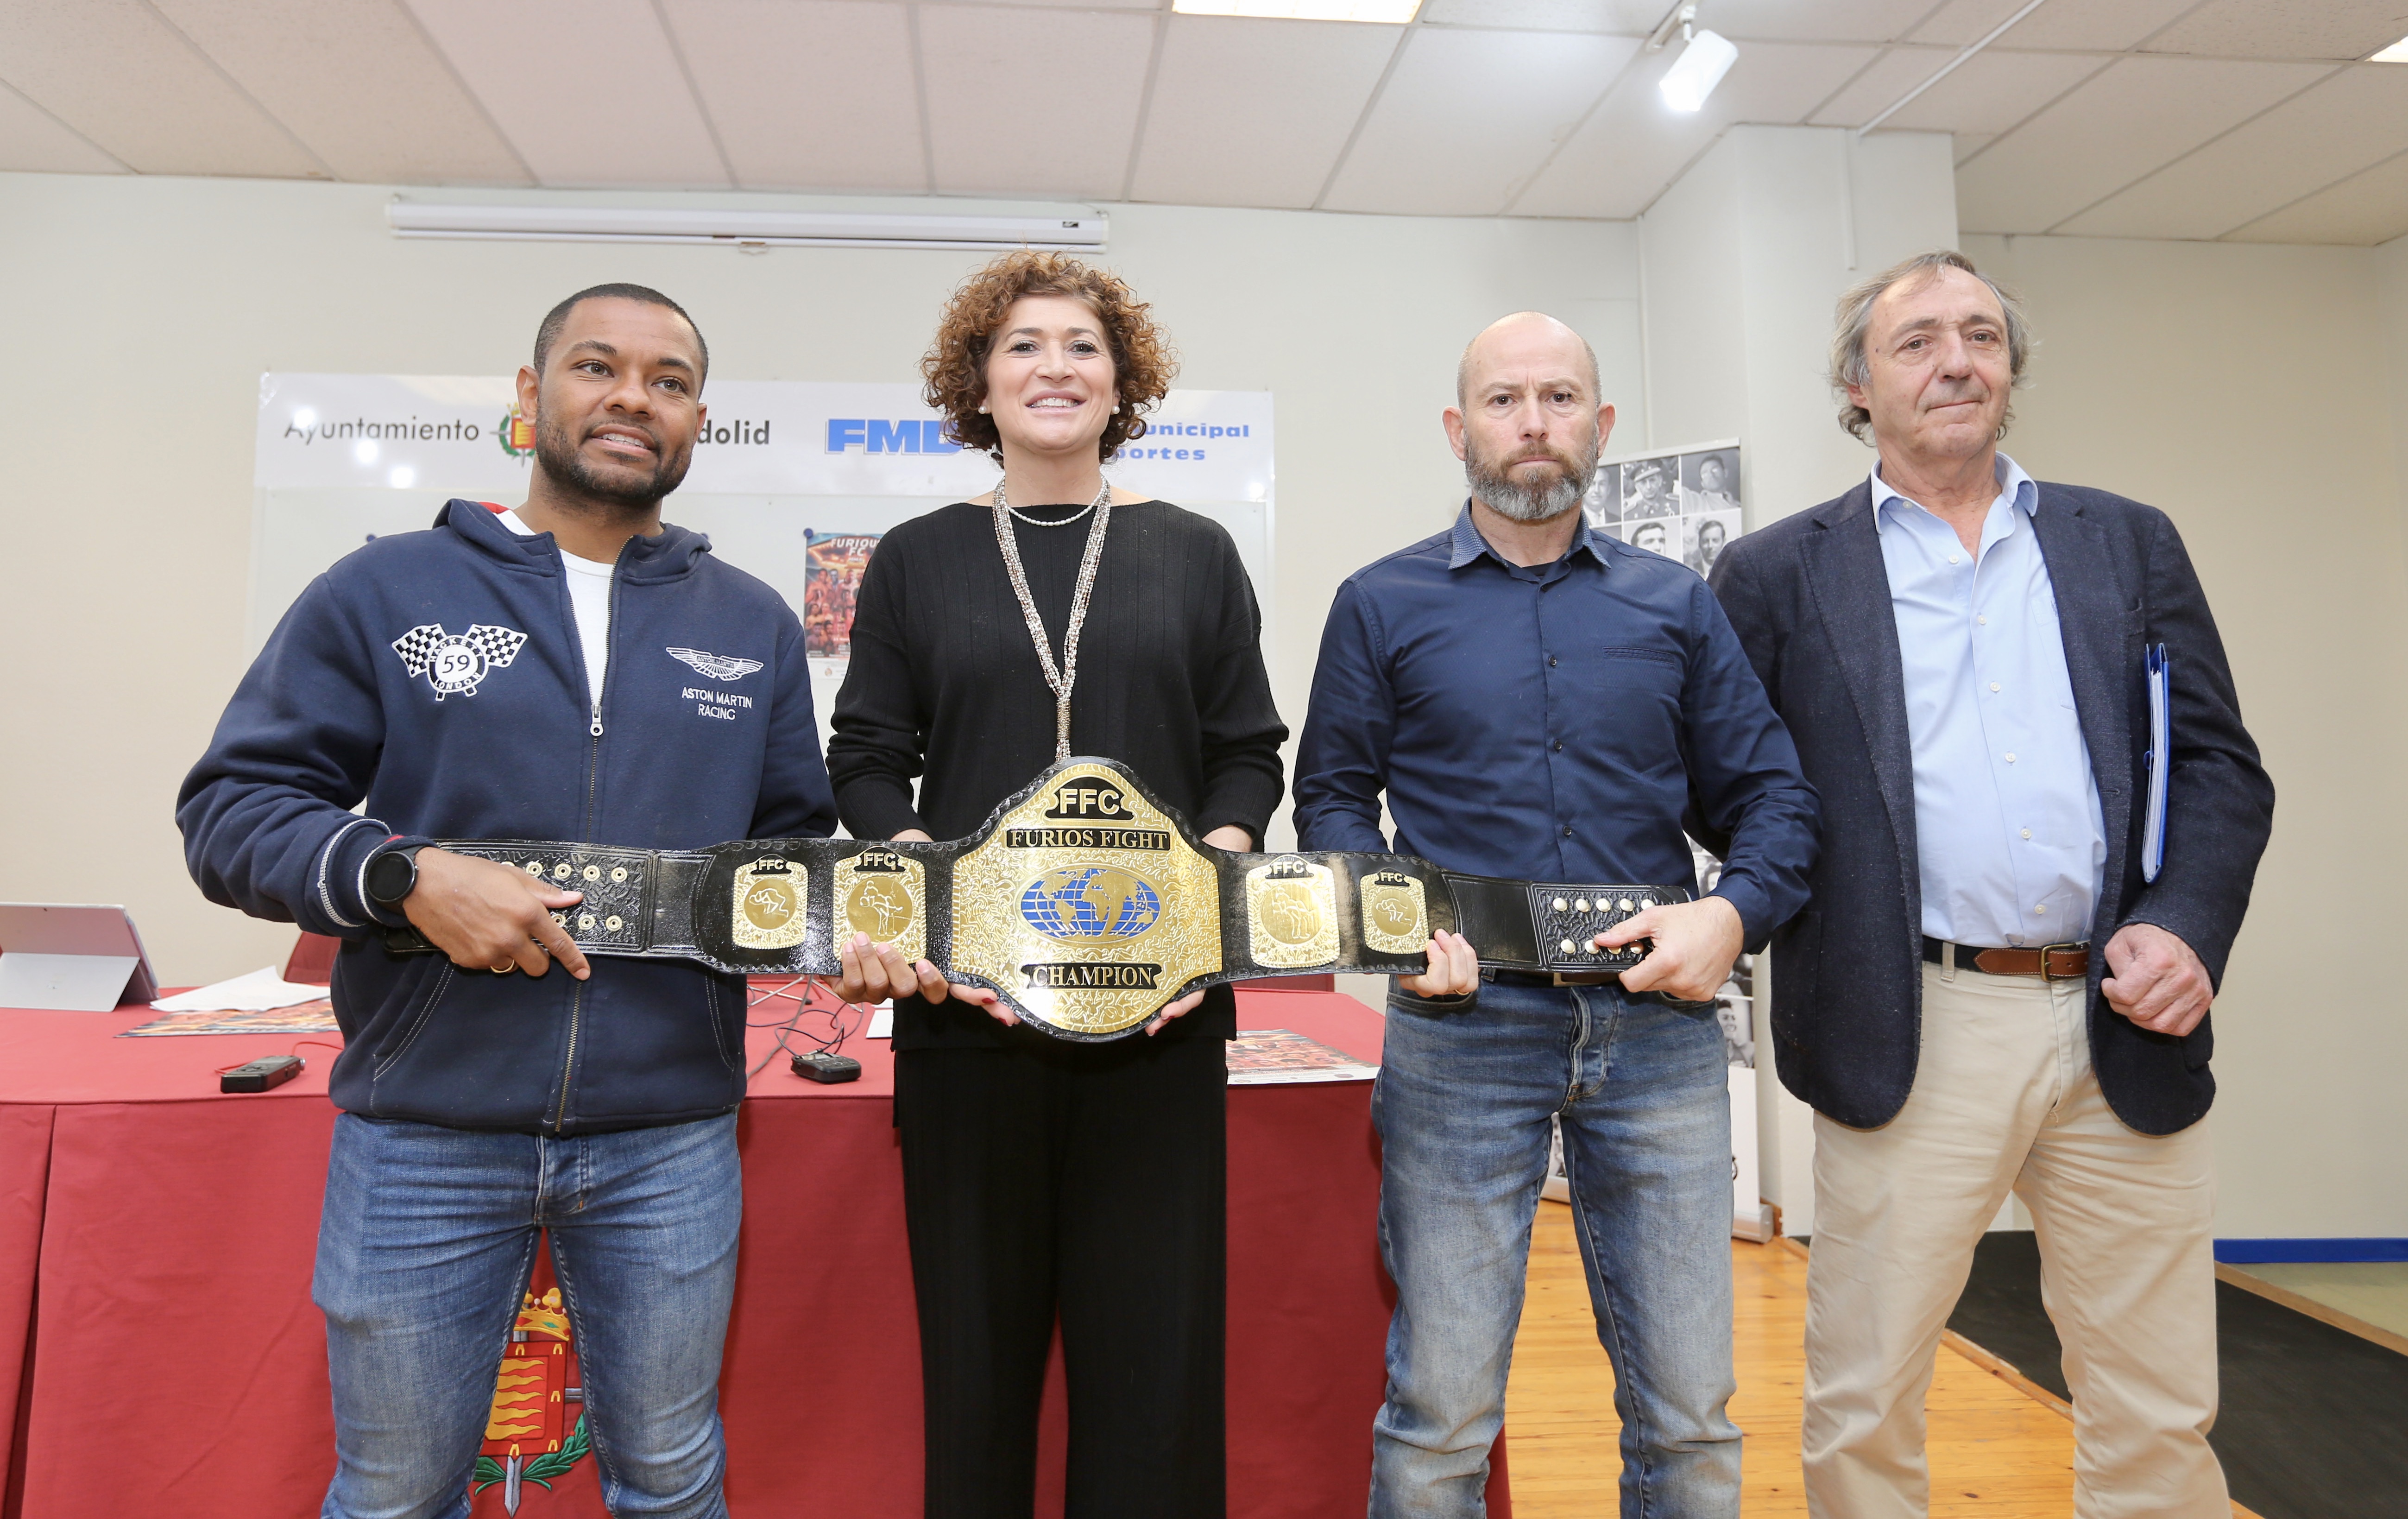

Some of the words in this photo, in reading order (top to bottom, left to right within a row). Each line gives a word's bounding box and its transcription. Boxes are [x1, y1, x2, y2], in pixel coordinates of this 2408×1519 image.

[284, 415, 479, 445] Ayuntamiento
[697, 419, 770, 445] dolid
[1130, 422, 1249, 439] unicipal
[1113, 447, 1205, 460] portes
[848, 547, 866, 557] FC
[429, 637, 483, 663] HACKETT
[441, 654, 471, 673] 59
[715, 659, 735, 668] MARTIN
[434, 672, 482, 690] LONDON
[681, 686, 714, 703] ASTON
[716, 691, 752, 709] MARTIN
[698, 703, 736, 721] RACING
[1058, 788, 1122, 815] FFC
[1010, 829, 1095, 848] FURIOS
[1099, 830, 1167, 849] FIGHT
[758, 859, 784, 871] FFC
[863, 852, 899, 868] FFC
[1273, 860, 1304, 874] FFC
[1380, 871, 1403, 883] FFC
[1032, 966, 1153, 987] CHAMPION
